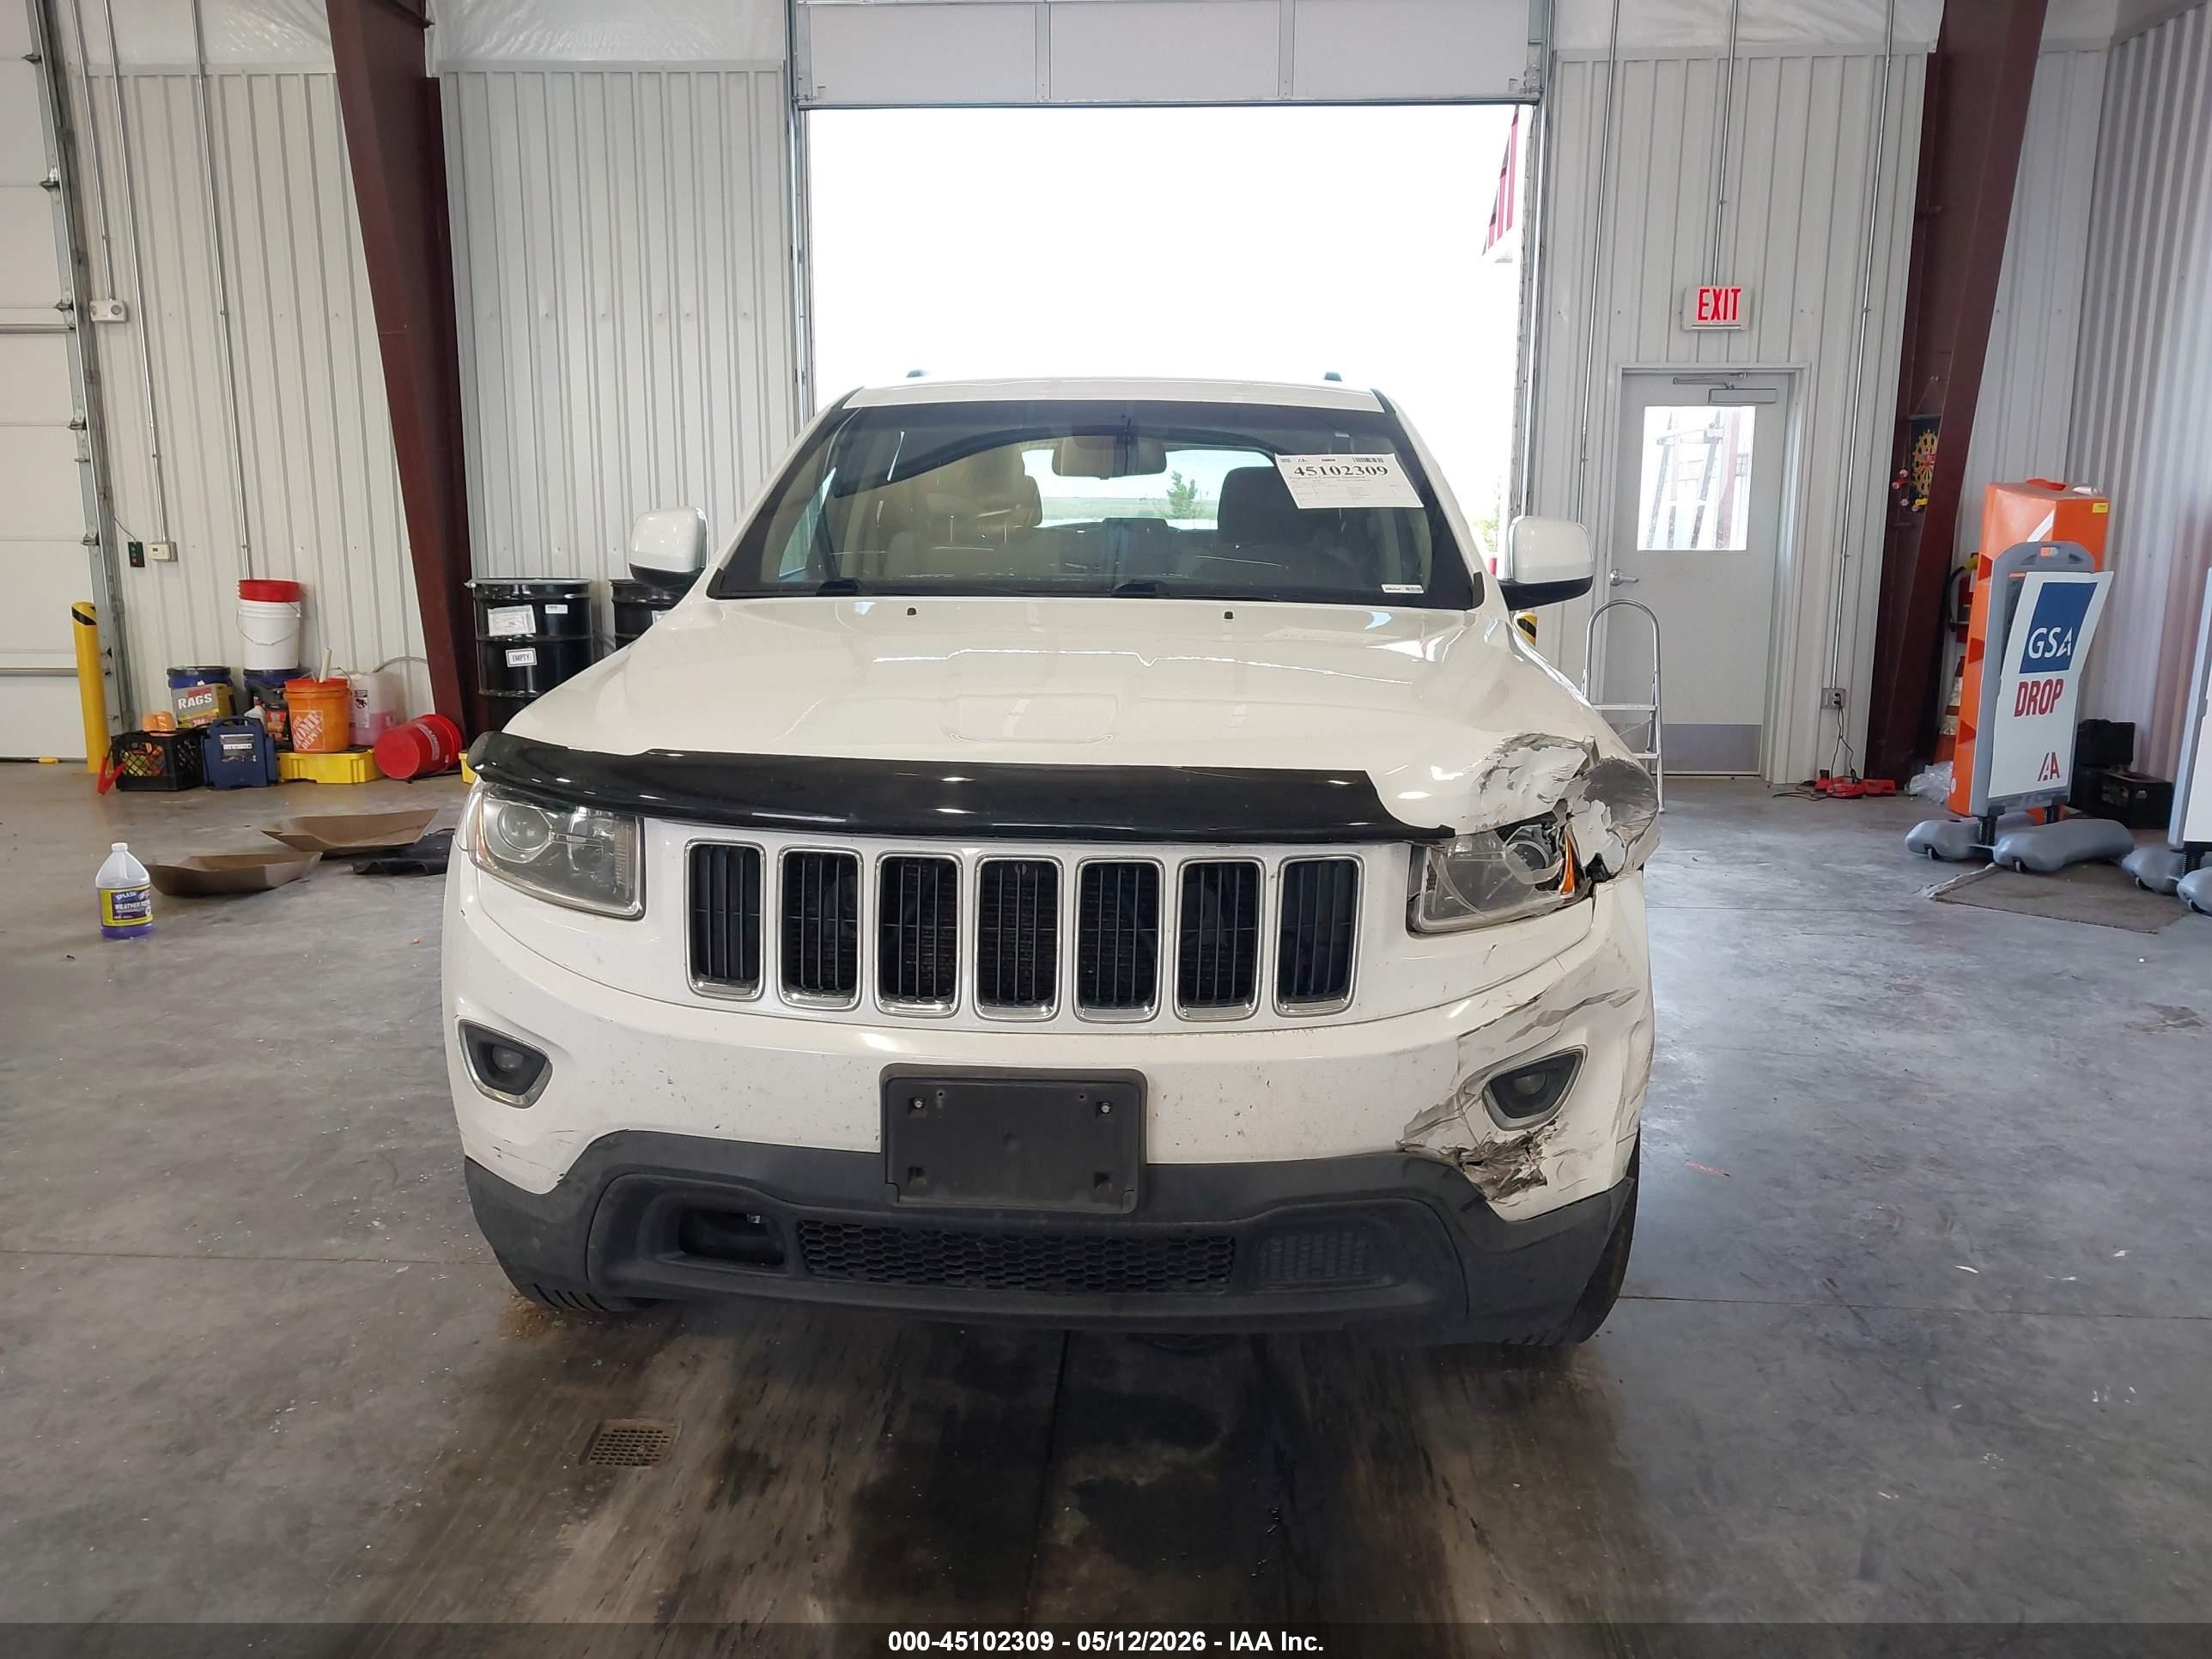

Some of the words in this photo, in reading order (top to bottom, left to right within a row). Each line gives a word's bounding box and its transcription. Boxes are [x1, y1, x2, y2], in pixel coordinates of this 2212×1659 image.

[1698, 288, 1741, 321] EXIT
[1293, 465, 1389, 477] 45102309
[2027, 627, 2073, 659] GSA
[512, 653, 530, 662] EMPTY
[178, 693, 213, 710] RAGS
[2014, 678, 2064, 718] DROP
